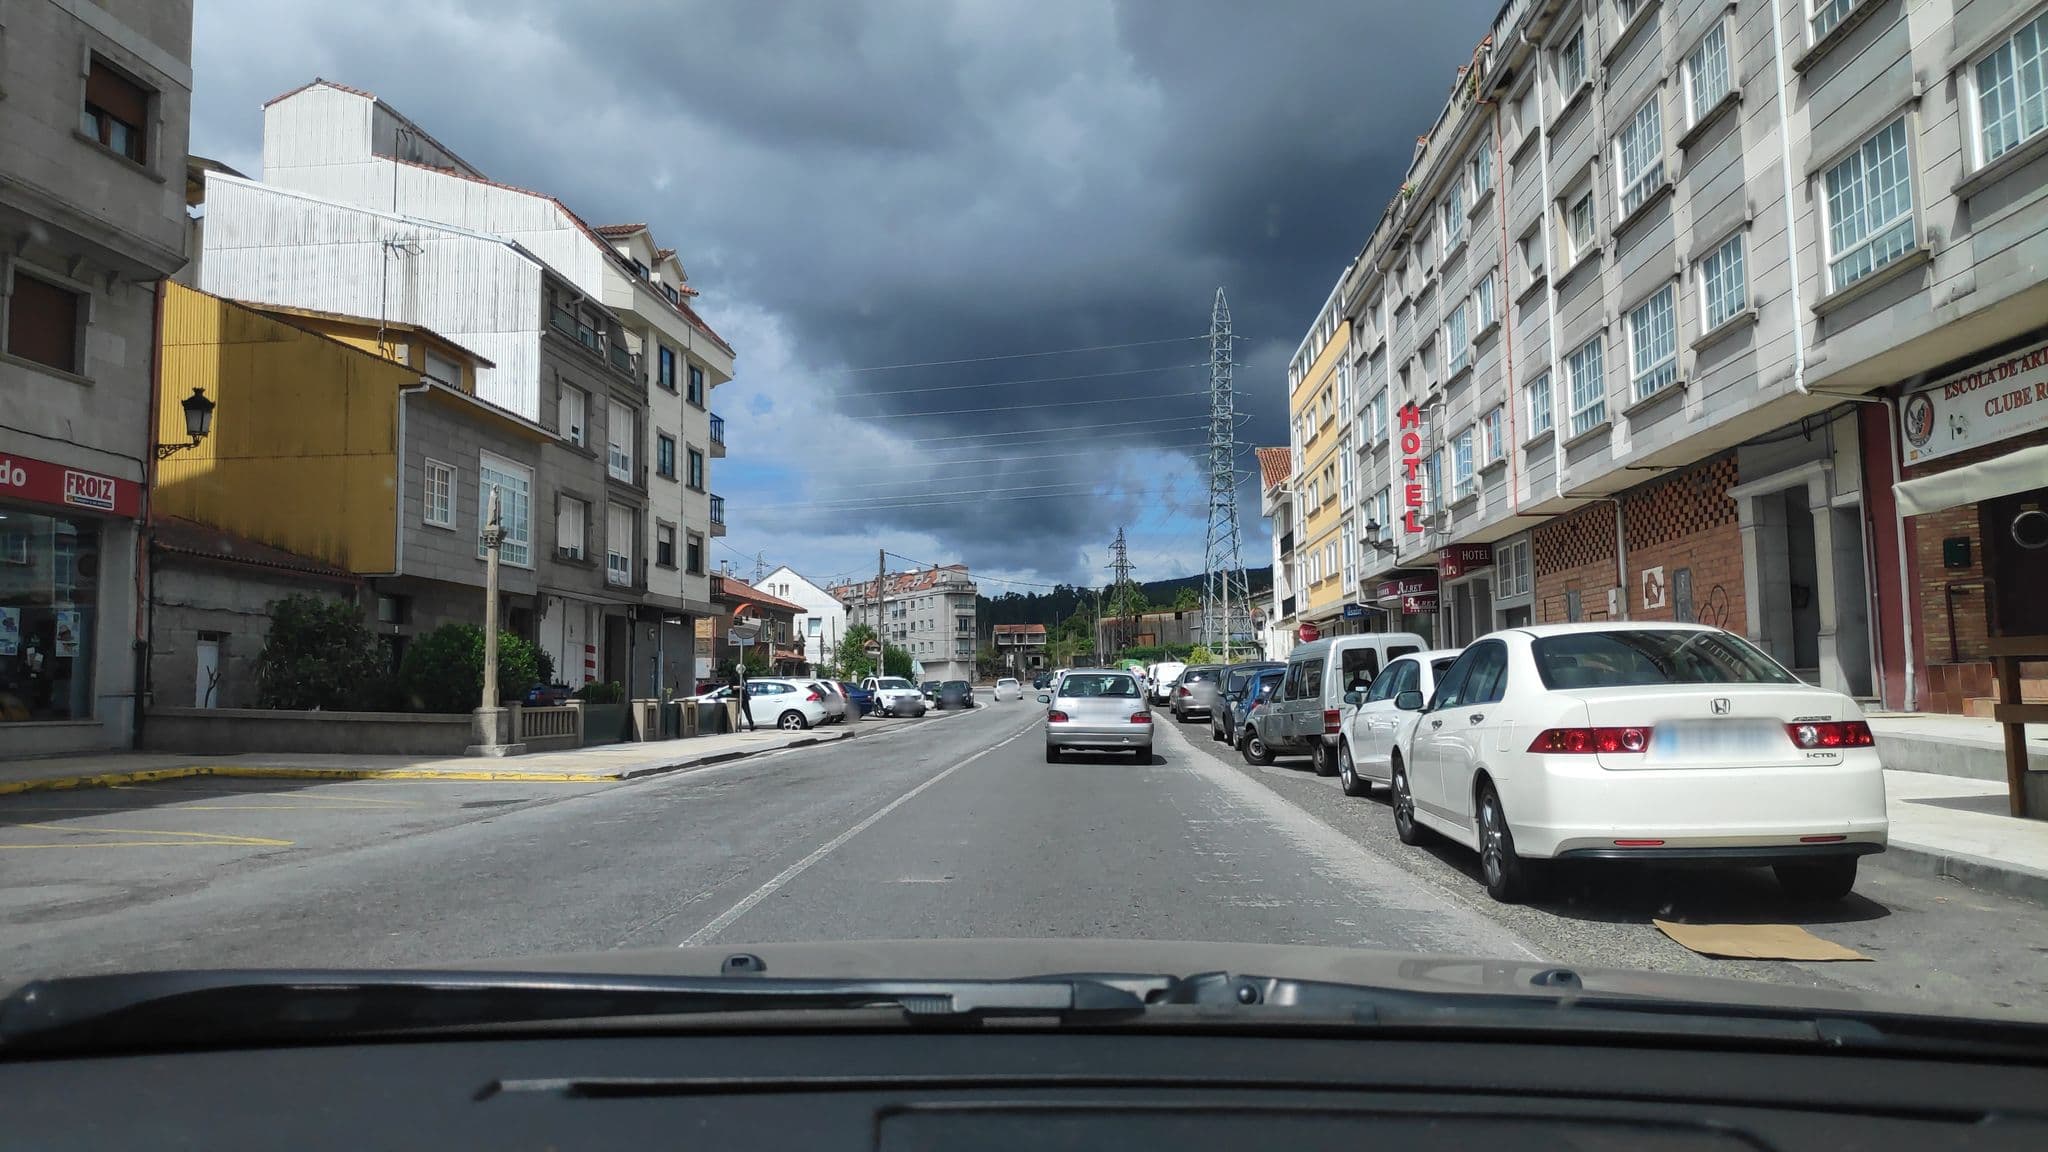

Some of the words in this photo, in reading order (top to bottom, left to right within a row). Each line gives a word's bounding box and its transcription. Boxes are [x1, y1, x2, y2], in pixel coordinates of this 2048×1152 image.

[1944, 367, 1997, 401] ESCOLA
[1998, 358, 2018, 381] DE
[1985, 386, 2032, 417] CLUBE
[1400, 405, 1424, 533] HOTEL
[66, 472, 113, 501] FROIZ
[1462, 549, 1489, 561] HOTEL
